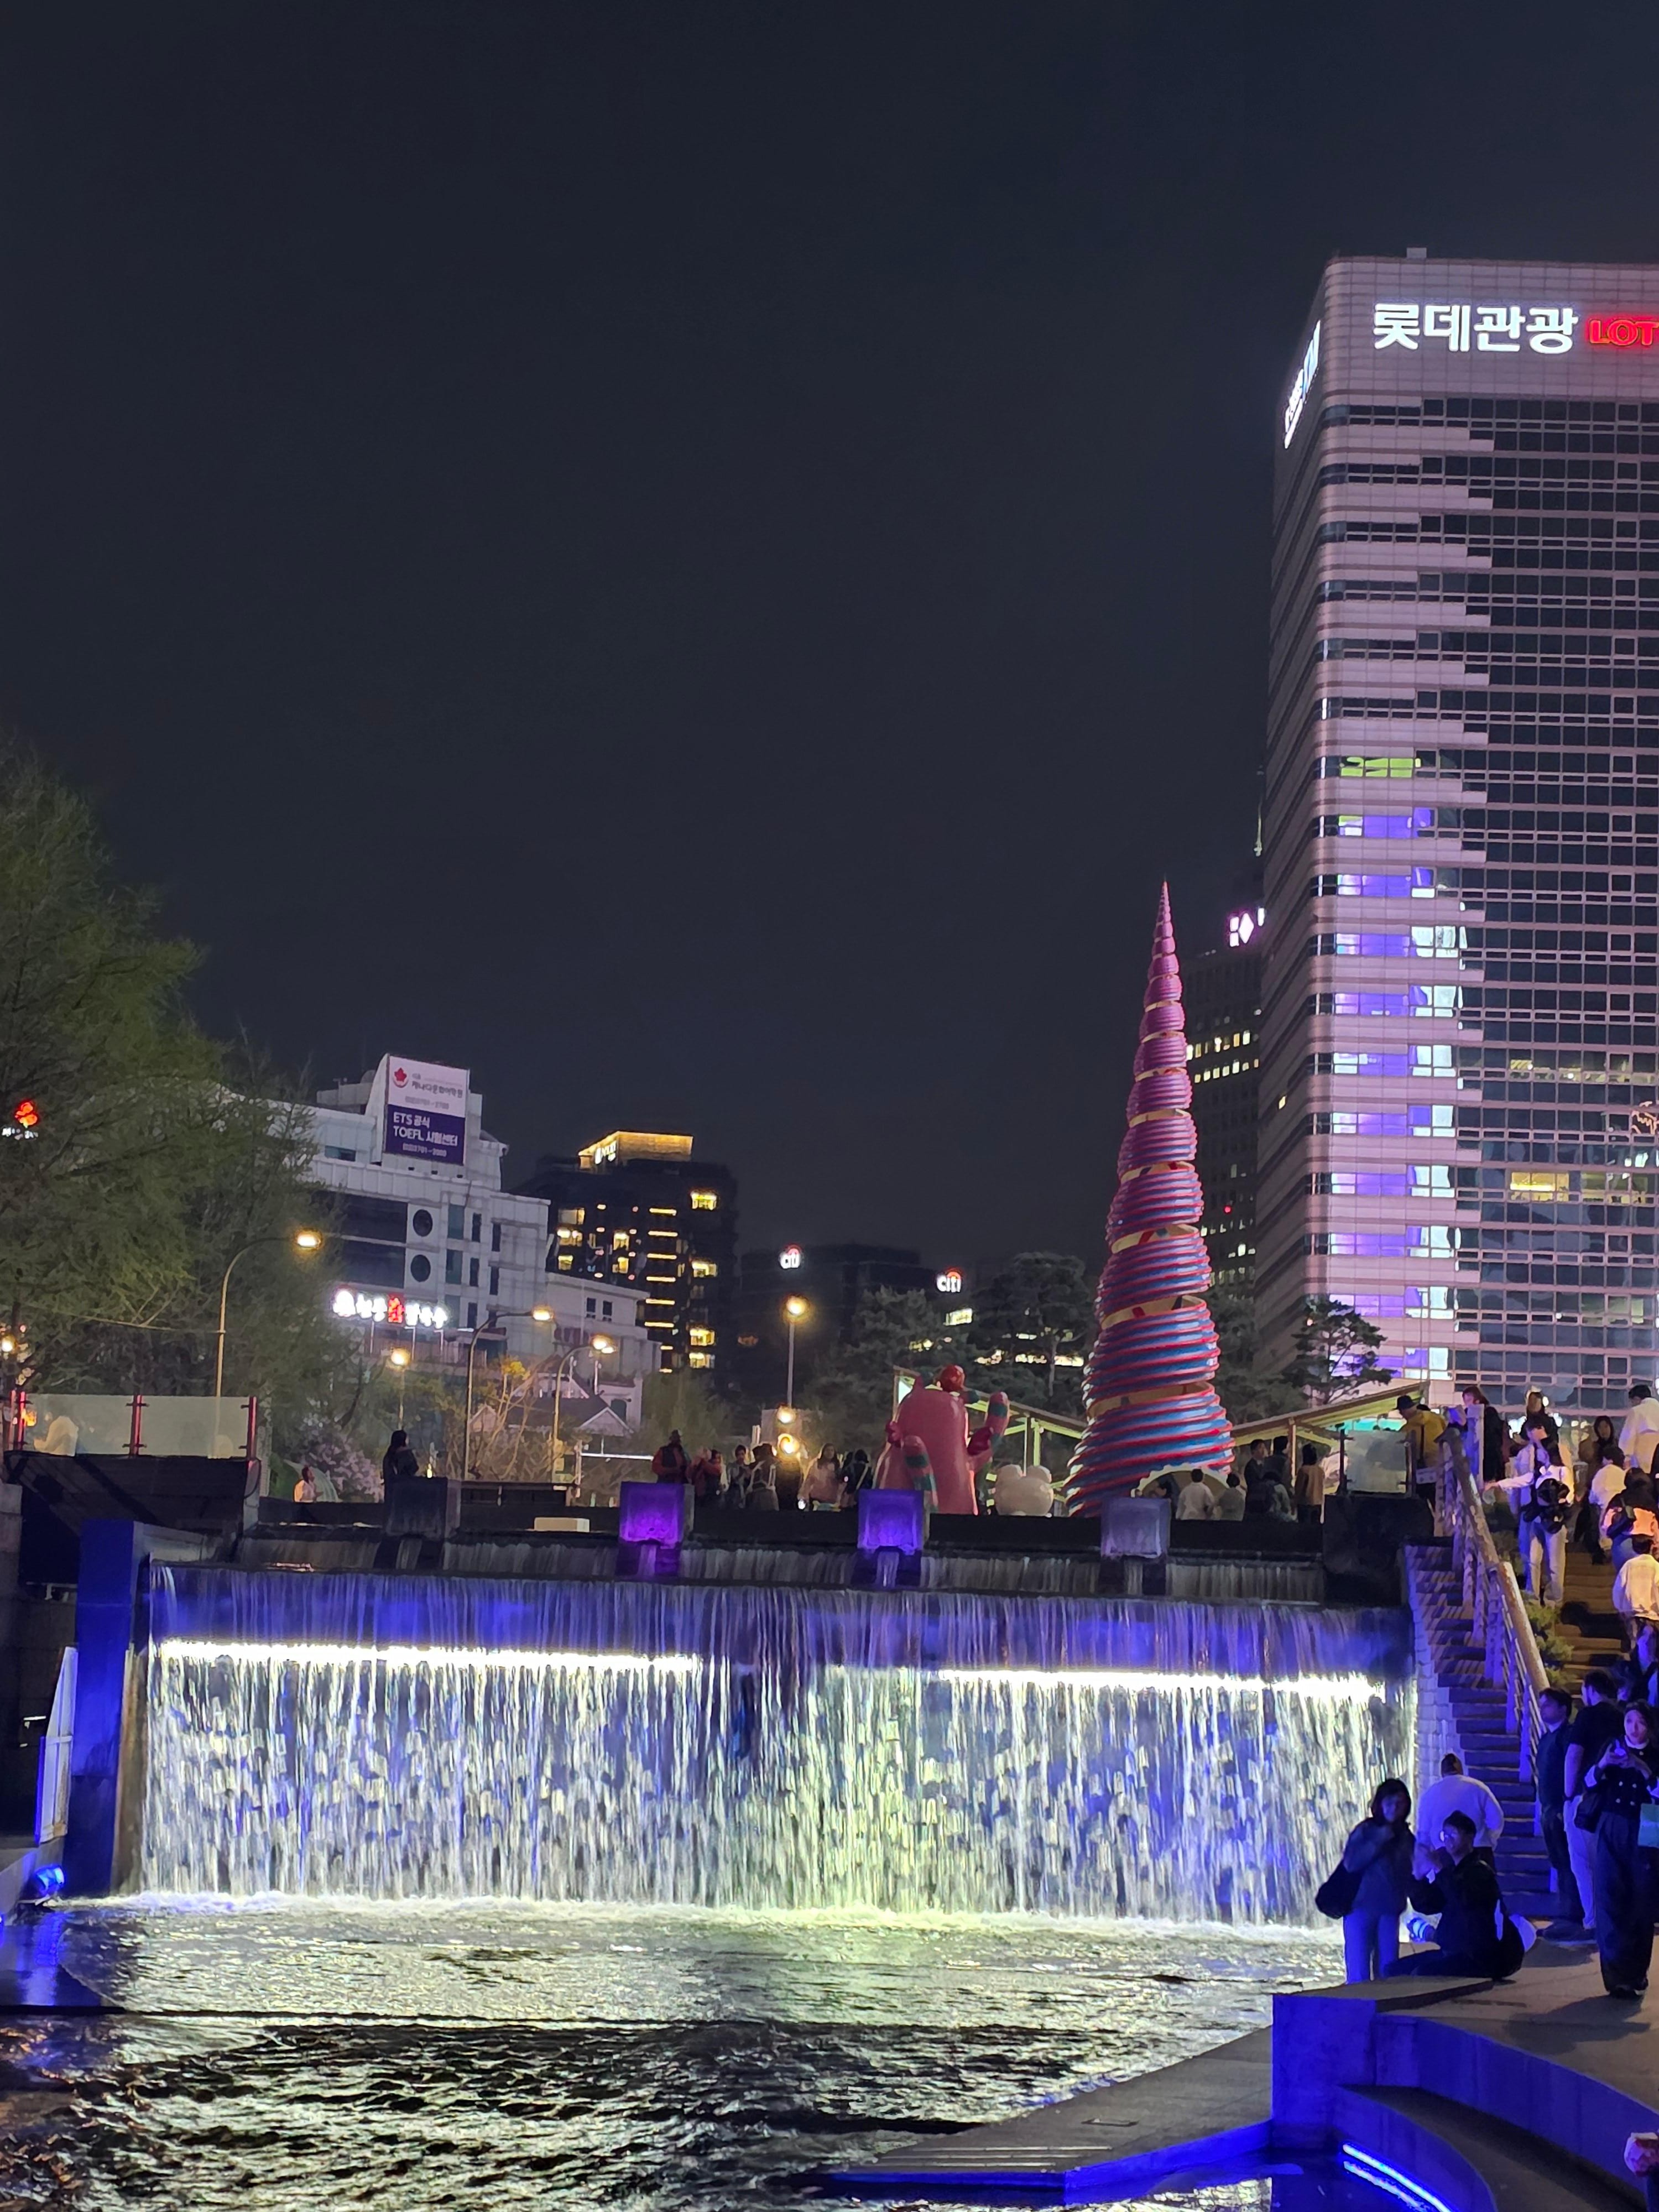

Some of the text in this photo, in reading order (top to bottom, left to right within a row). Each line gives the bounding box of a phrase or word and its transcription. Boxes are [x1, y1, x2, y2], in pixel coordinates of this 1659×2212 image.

[1373, 303, 1579, 354] 롯데관광
[393, 1112, 413, 1125] ETS
[393, 1125, 425, 1141] TOEFL
[780, 1248, 801, 1269] citi
[937, 1271, 962, 1293] citi
